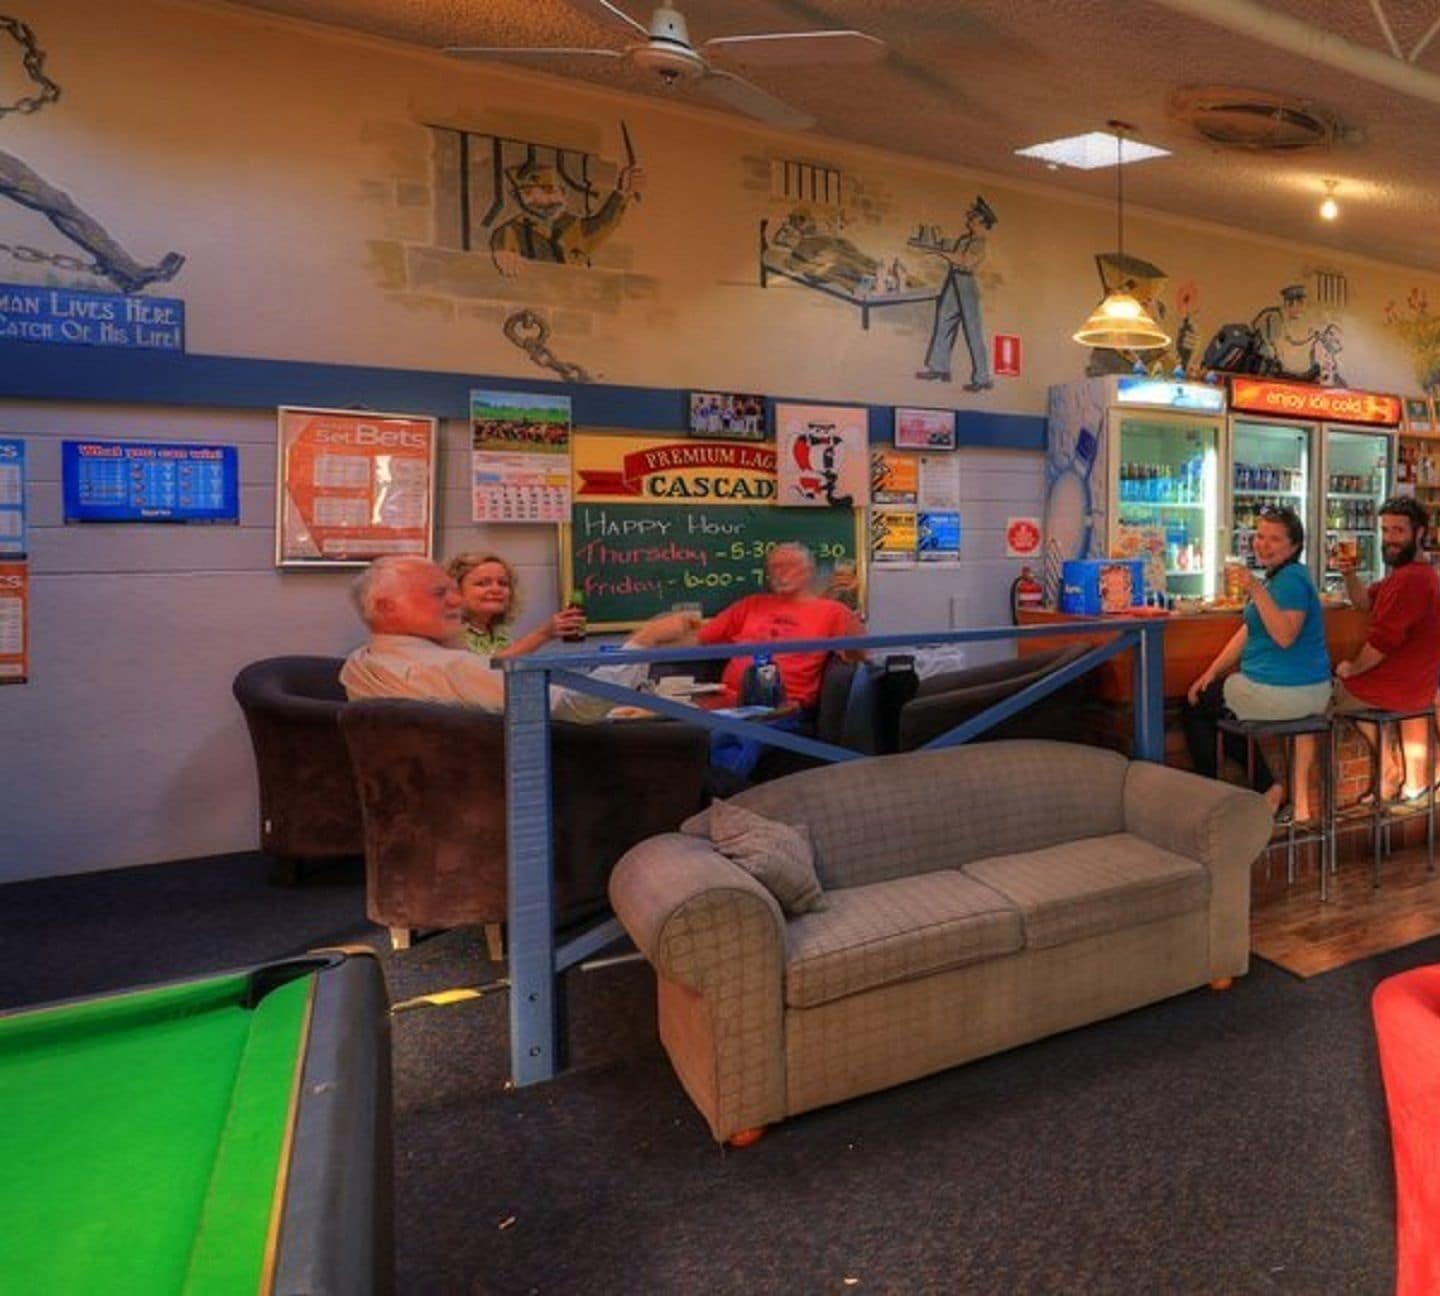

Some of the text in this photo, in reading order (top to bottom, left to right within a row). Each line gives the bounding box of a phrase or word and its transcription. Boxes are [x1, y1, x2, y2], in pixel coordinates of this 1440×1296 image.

[1266, 390, 1362, 413] enjoy ice cold
[646, 448, 735, 470] PREMIUM
[650, 476, 777, 499] CASCAD
[688, 513, 747, 536] Hour
[576, 538, 708, 567] Thursday
